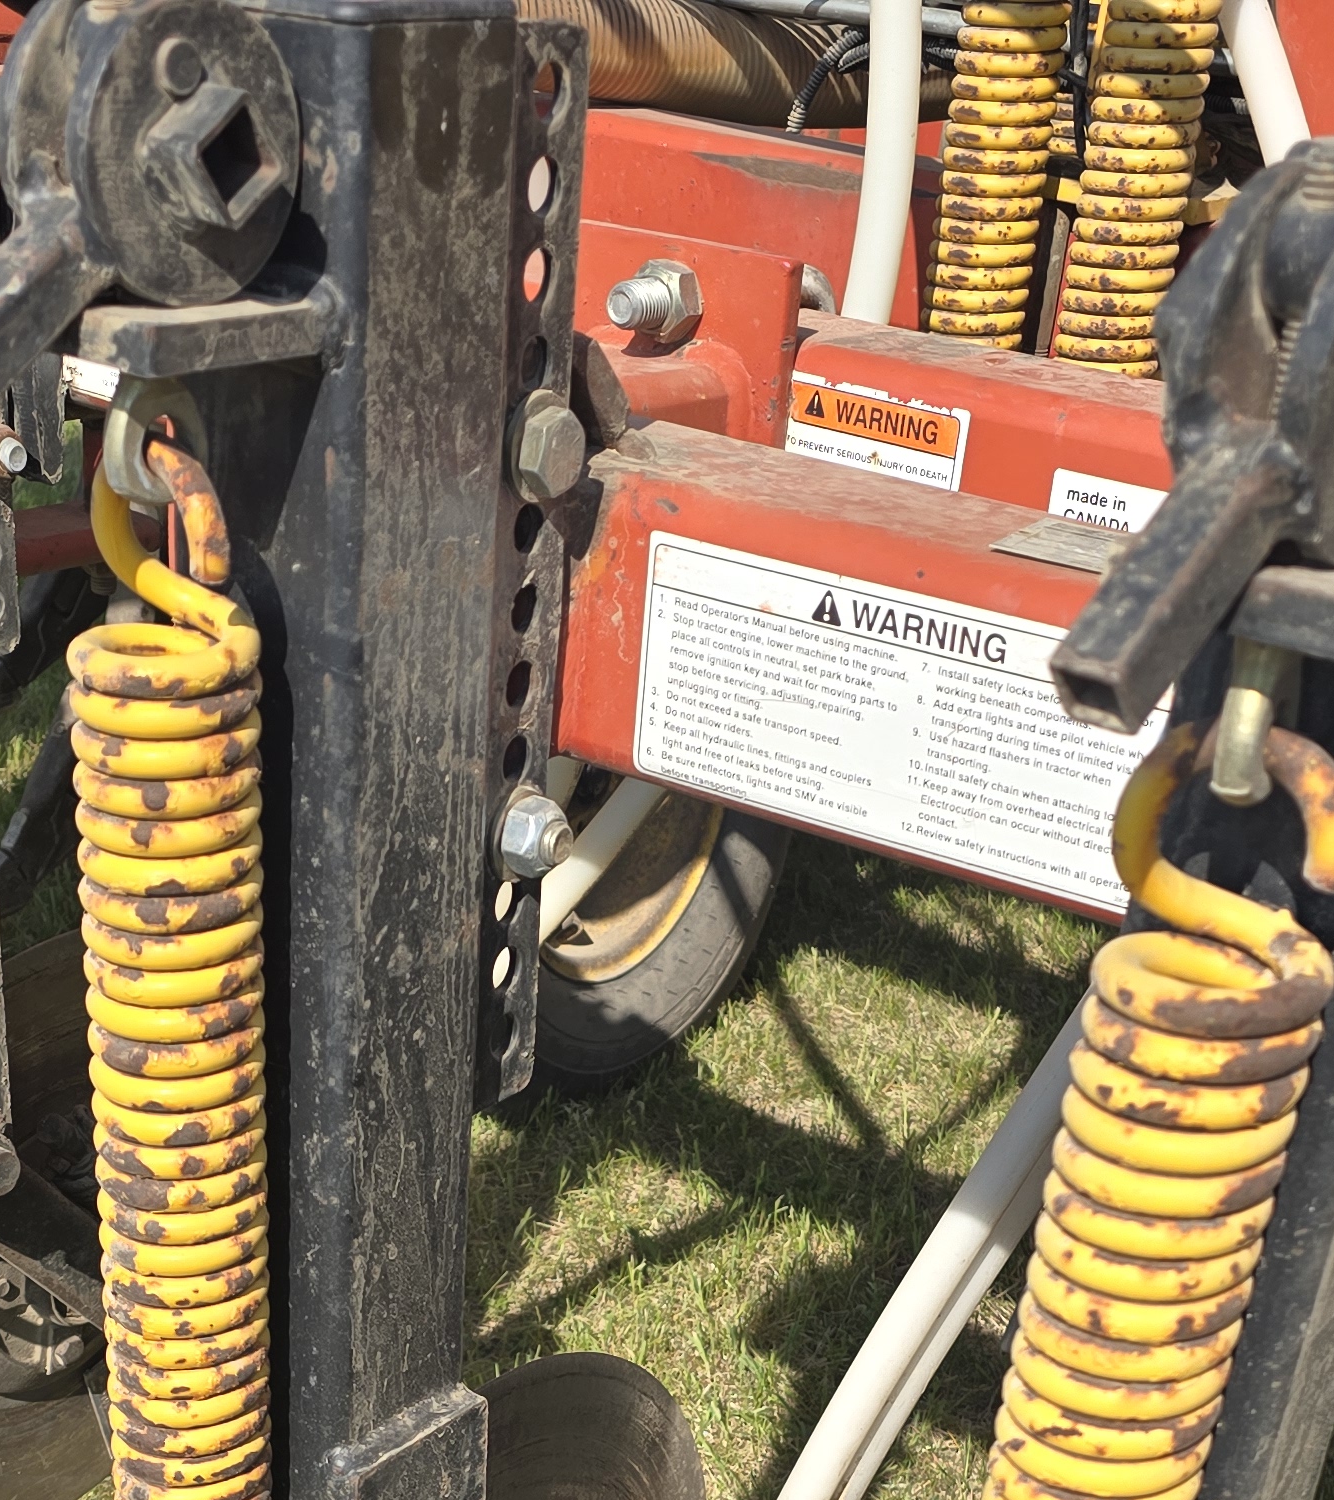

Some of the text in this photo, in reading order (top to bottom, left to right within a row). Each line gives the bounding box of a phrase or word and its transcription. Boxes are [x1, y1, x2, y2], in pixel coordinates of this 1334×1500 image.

[837, 398, 938, 445] WARNING
[798, 439, 948, 482] PREVENT SERIOUS INJURY OR DEATH
[1067, 489, 1126, 512] made in
[673, 612, 694, 627] Stop
[697, 619, 727, 634] tractor
[766, 636, 793, 650] lower
[795, 646, 836, 663] machine
[839, 656, 849, 666] to
[852, 659, 867, 671] the
[674, 596, 698, 611] Read
[700, 603, 748, 624] Operator's
[751, 616, 786, 633] Manual
[789, 626, 819, 642] before
[822, 636, 850, 652] using
[853, 599, 1007, 664] WARNING
[668, 661, 688, 673] stop
[691, 665, 721, 681] before
[669, 645, 897, 711] remove ignition key and wait for moving parts to
[671, 630, 696, 643] place
[698, 637, 710, 646] all
[712, 640, 750, 657] controls
[752, 650, 761, 659] in
[802, 664, 817, 674] set
[819, 669, 841, 681] park
[667, 676, 719, 699] unplugging
[721, 691, 731, 699] or
[935, 684, 1020, 712] working beneath
[937, 666, 1033, 698] Install safety locks
[665, 705, 677, 716] Do
[679, 711, 694, 721] not
[697, 716, 721, 728] allow
[666, 689, 678, 701] Do
[681, 696, 696, 706] not
[698, 701, 731, 715] exceed
[742, 712, 761, 724] safe
[764, 717, 806, 736] transport
[932, 699, 1124, 755] Add extra lights and use pilot vehicle
[662, 735, 682, 749] tight
[684, 743, 701, 754] and
[704, 747, 721, 760] free
[724, 754, 733, 763] of
[736, 756, 759, 771] leaks
[762, 764, 792, 780] before
[663, 720, 686, 735] Keep
[688, 729, 699, 738] all
[702, 731, 744, 751] hydraulic
[774, 751, 806, 769] fittings
[809, 763, 827, 774] and
[829, 768, 871, 786] couplers
[929, 730, 1111, 786] Use hazard flashers in tractor when
[931, 715, 993, 741] transporting
[995, 732, 1029, 750] during
[1032, 741, 1060, 756] times
[1063, 750, 1075, 759] of
[1077, 752, 1113, 770] limited
[660, 765, 689, 780] before
[661, 750, 672, 761] Be
[675, 756, 695, 768] sure
[746, 775, 771, 789] lights
[773, 784, 791, 795] and
[794, 788, 816, 802] SMV
[818, 797, 833, 807] are
[836, 803, 867, 817] visible
[924, 762, 1100, 820] Install safety chain when attaching
[920, 794, 1080, 846] Electrocution can occur without
[922, 778, 947, 794] Keep
[950, 788, 977, 803] away
[979, 793, 1002, 808] from
[1005, 803, 1054, 821] overhead
[1056, 816, 1104, 834] electrical
[916, 825, 1086, 880] Review safety instructions with all
